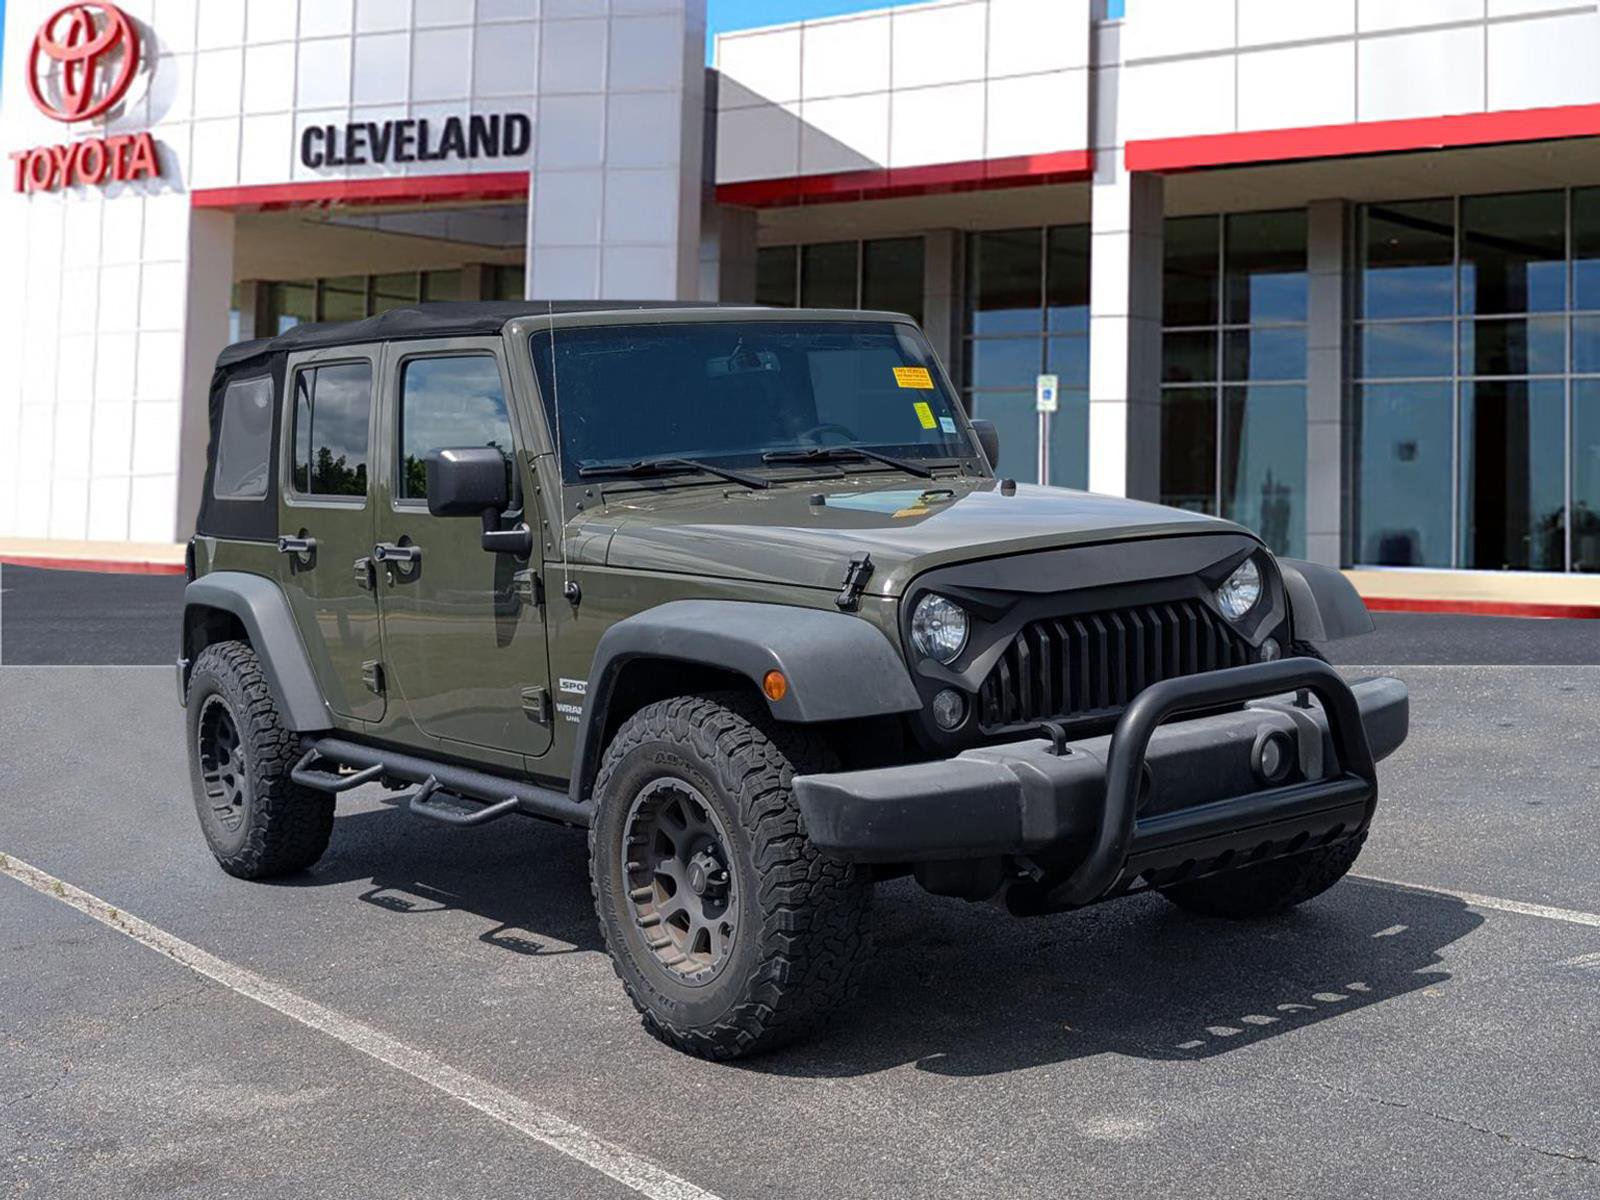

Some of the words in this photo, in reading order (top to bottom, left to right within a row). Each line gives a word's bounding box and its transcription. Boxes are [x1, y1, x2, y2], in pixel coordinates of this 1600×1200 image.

[8, 132, 160, 193] TOYOTA
[301, 113, 531, 169] CLEVELAND
[560, 680, 586, 692] SPO
